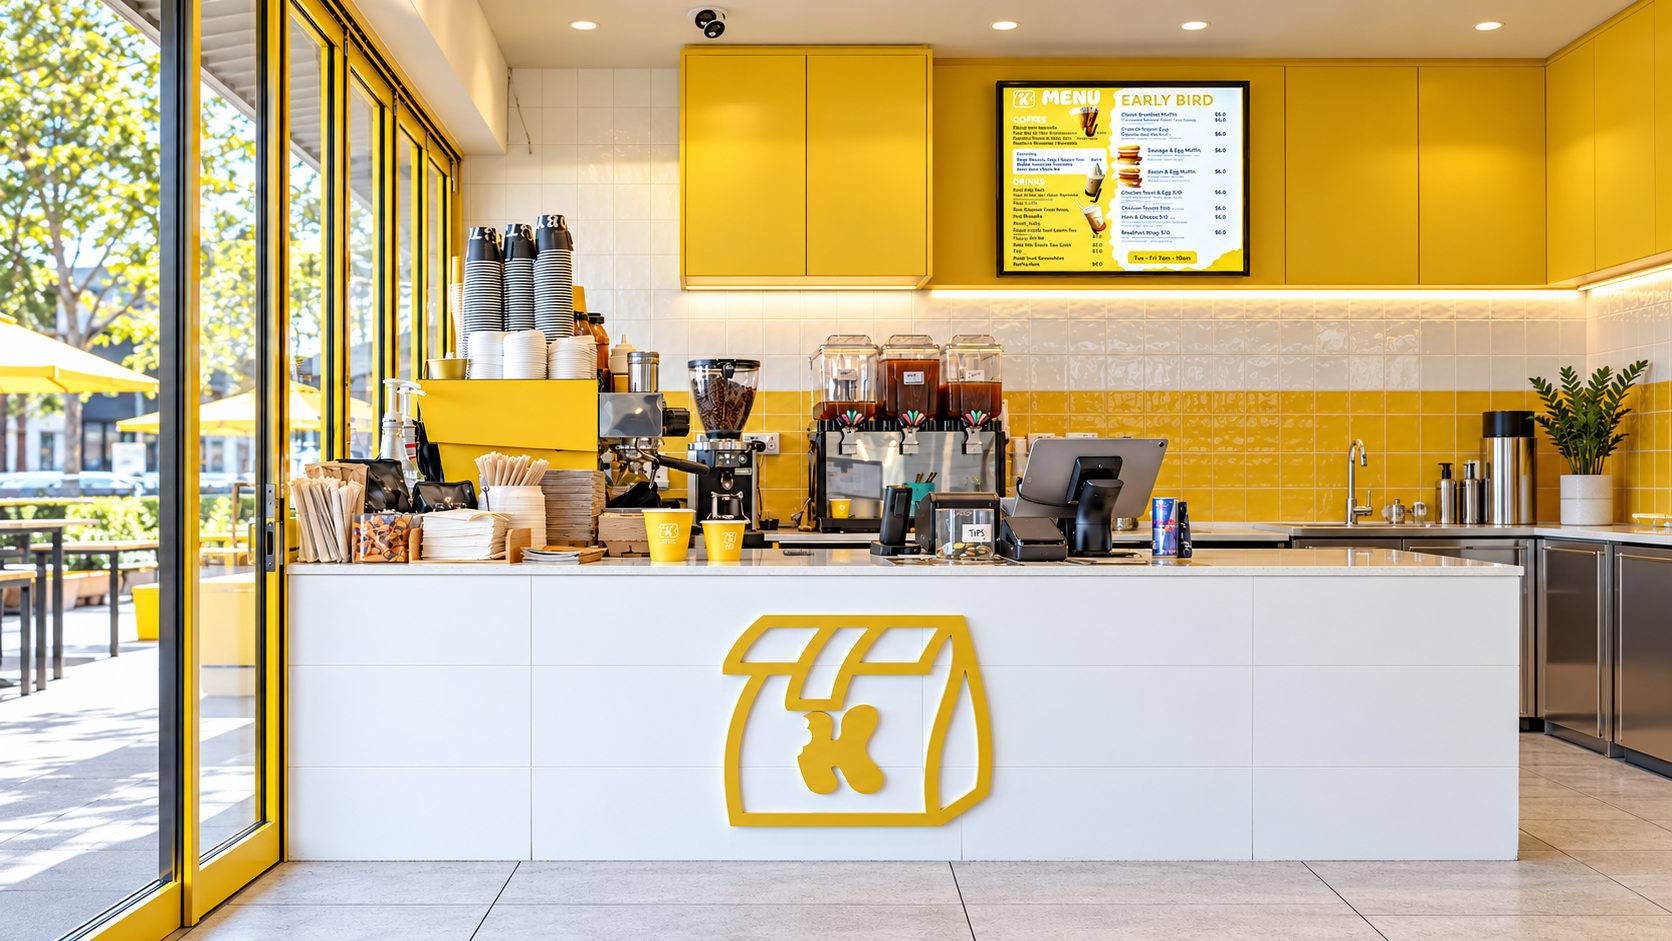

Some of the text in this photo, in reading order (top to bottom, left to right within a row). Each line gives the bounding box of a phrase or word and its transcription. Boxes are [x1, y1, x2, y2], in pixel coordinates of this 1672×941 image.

[1041, 89, 1101, 106] MENU
[1121, 94, 1214, 106] EARLY BIRD
[1012, 115, 1047, 124] COFFEE
[1012, 178, 1046, 186] DRINKS
[968, 528, 985, 538] TIPS
